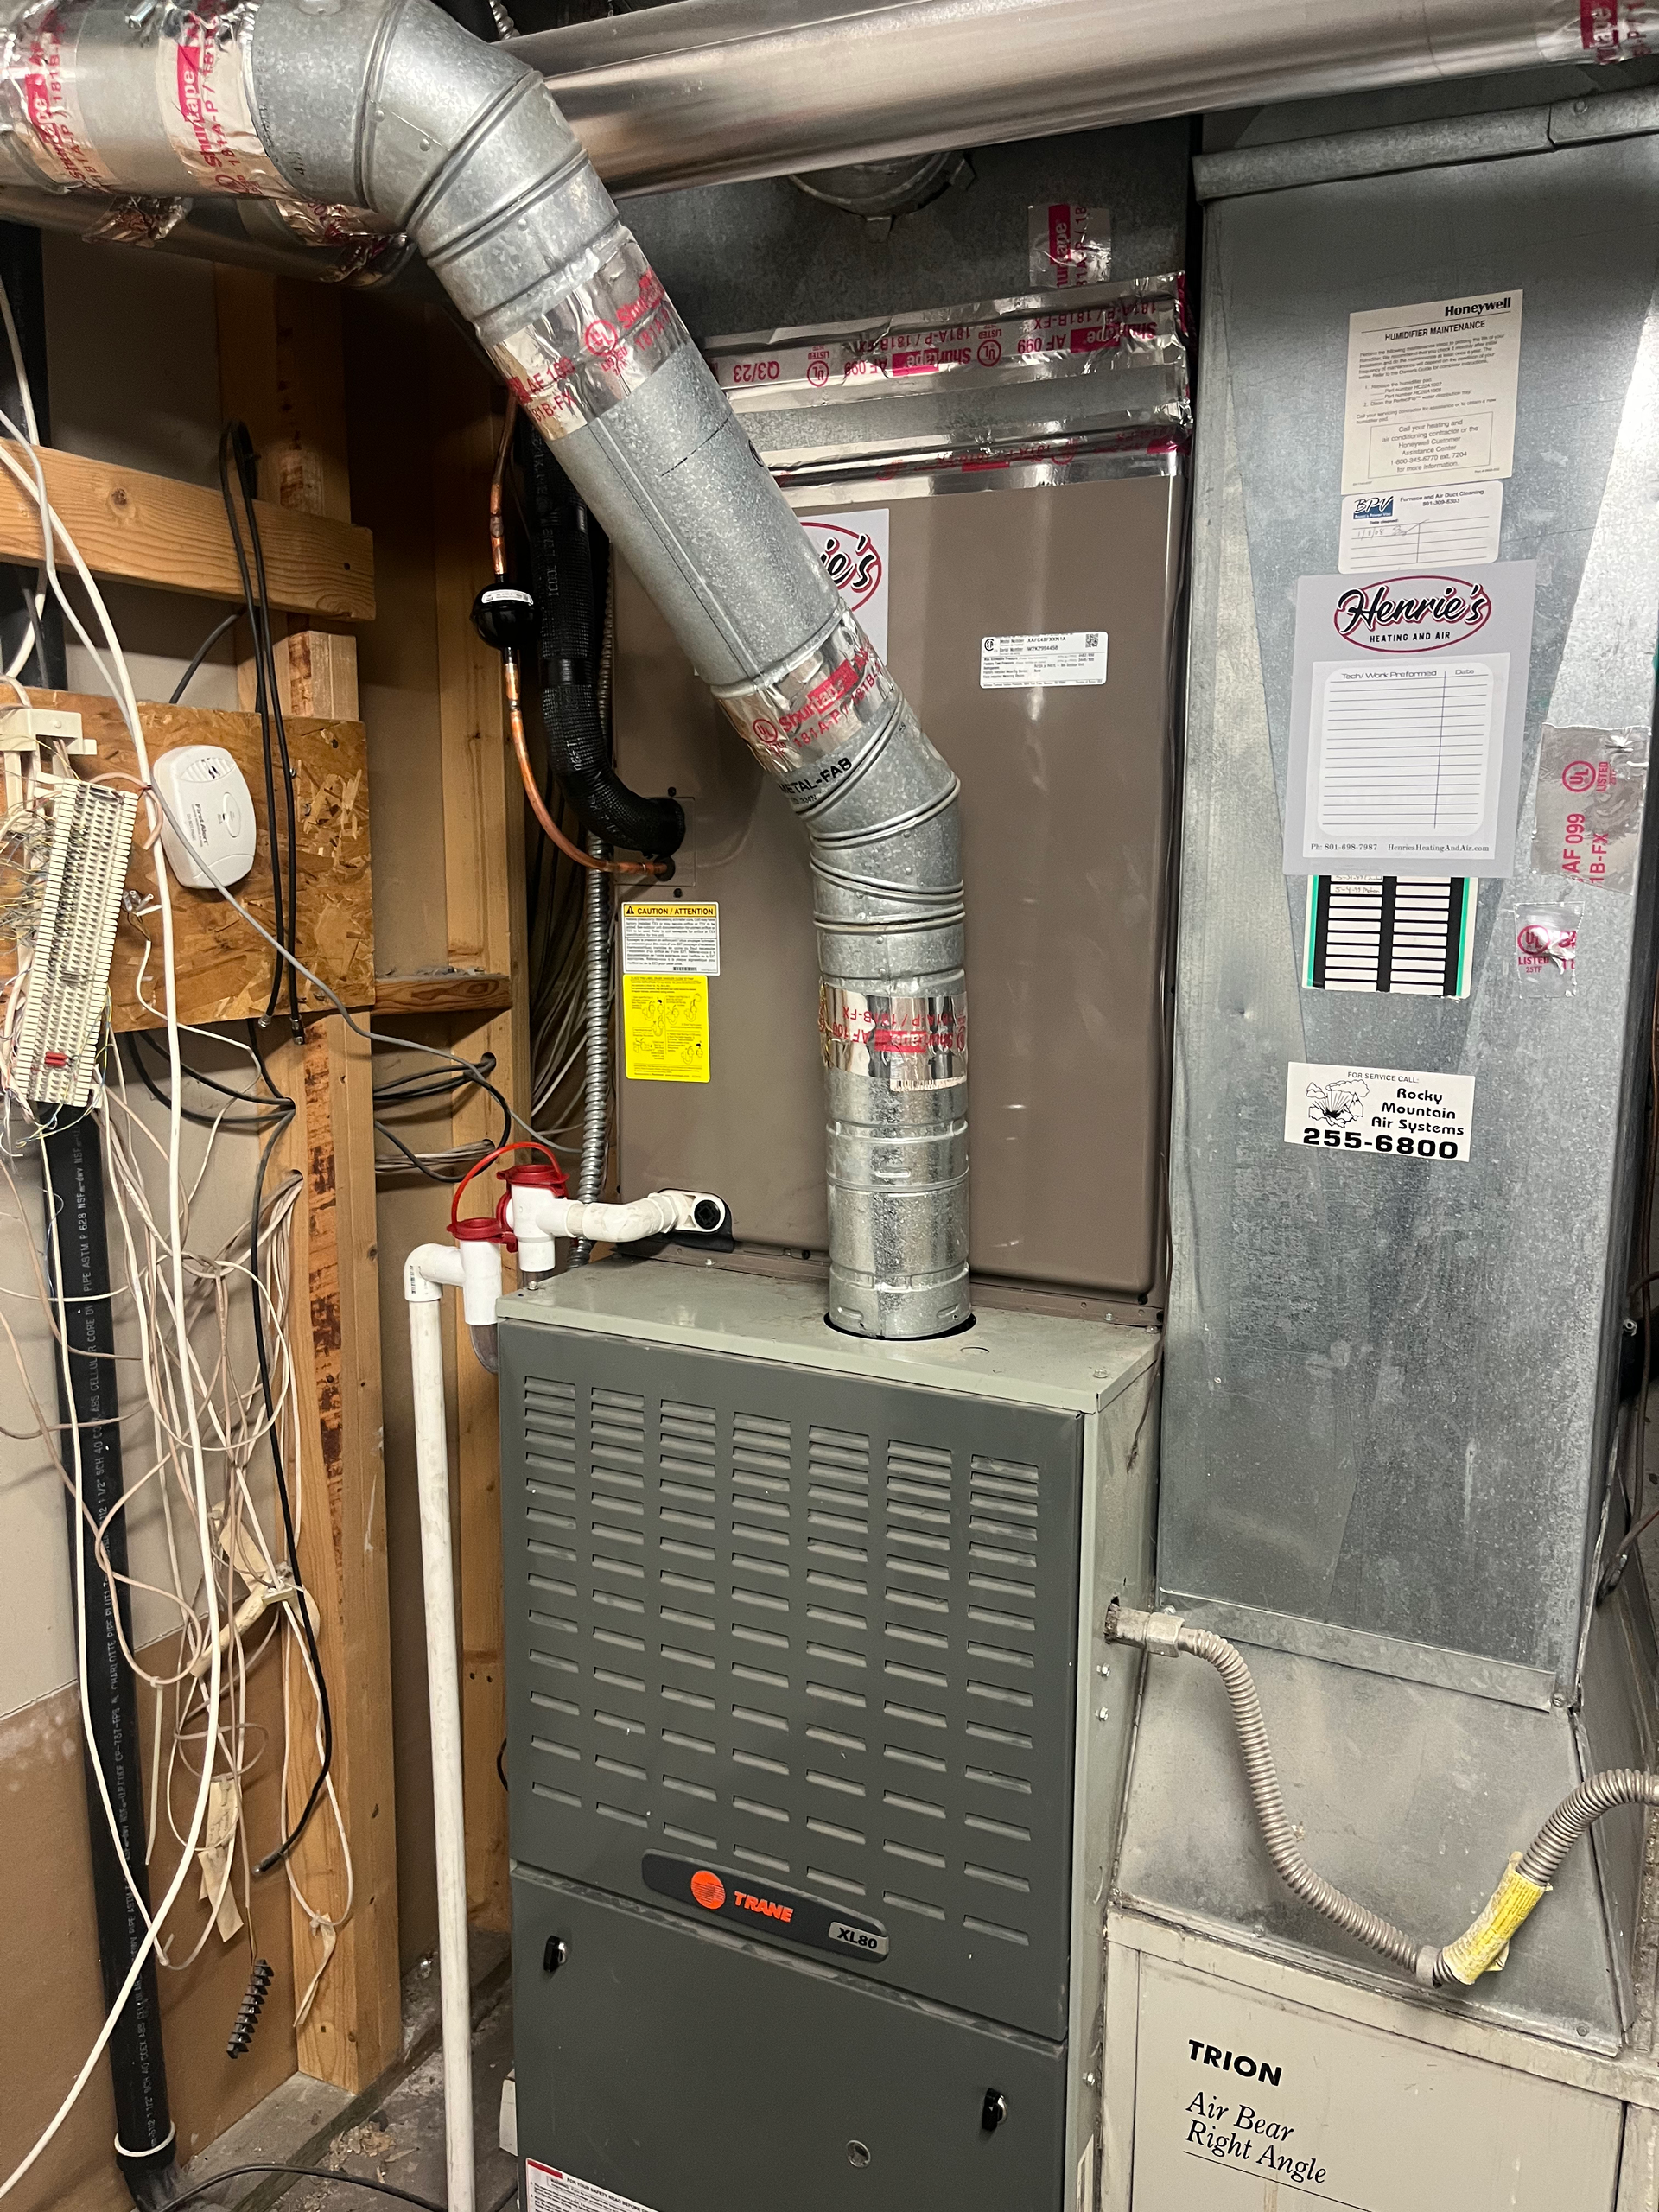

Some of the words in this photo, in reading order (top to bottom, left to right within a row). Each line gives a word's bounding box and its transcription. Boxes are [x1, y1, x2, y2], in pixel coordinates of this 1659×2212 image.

[183, 70, 223, 168] Shurtape
[205, 100, 241, 167] 181A-P
[1445, 296, 1512, 317] Honeywell
[1034, 311, 1084, 330] 181B-FX
[1384, 328, 1428, 341] HUMIDIFIER
[1429, 320, 1486, 335] MAINTENANCE
[924, 327, 973, 345] 181A-P
[977, 327, 1003, 340] LISTED
[1046, 334, 1068, 353] AF
[1016, 335, 1045, 355] 099
[906, 347, 973, 369] Shurtape
[733, 360, 780, 384] Q3/23
[844, 359, 870, 378] 099
[1391, 431, 1427, 442] conditioning
[1428, 428, 1459, 437] contractor
[1411, 424, 1426, 433] your
[1398, 439, 1430, 448] Honeywell
[1431, 435, 1461, 445] Customer
[1401, 447, 1434, 456] Assistance
[1435, 444, 1457, 453] Center
[1423, 461, 1459, 470] information.
[1354, 495, 1394, 512] BPV
[1338, 583, 1489, 634] Henrie's
[1370, 633, 1408, 643] HEATING
[1412, 632, 1431, 642] AND
[1435, 631, 1451, 639] AIR
[1389, 670, 1437, 678] Preformed
[779, 677, 846, 733] Shurtape
[792, 709, 841, 748] 181A-P
[779, 757, 853, 794] METAL-FAB
[1595, 760, 1609, 793] LISTED
[194, 804, 205, 823] First
[1564, 812, 1586, 844] 099
[1387, 843, 1490, 853] HenriesHeatingAndAir.com
[1561, 848, 1581, 874] AF
[1589, 832, 1609, 888] 1B-FX
[669, 907, 674, 916] /
[1517, 956, 1550, 966] LISTED
[851, 1028, 871, 1045] AF
[1364, 1072, 1396, 1082] SERVICE
[1397, 1075, 1420, 1084] CALL:
[1396, 1087, 1444, 1105] Rocky
[1381, 1101, 1456, 1120] Mountain
[1370, 1116, 1394, 1128] Air
[1398, 1119, 1465, 1136] Systems
[1303, 1127, 1459, 1160] 255-6800
[78, 1213, 88, 1231] 628
[80, 1243, 91, 1268] ASTM
[82, 1272, 92, 1292] PIPE
[86, 1318, 96, 1343] CORE
[88, 1345, 99, 1392] CELLULR
[90, 1395, 100, 1412] ABS
[94, 1441, 104, 1455] 40
[96, 1456, 105, 1476] SCH
[734, 1890, 794, 1923] TRANE
[836, 1927, 878, 1949] XL80
[1188, 2038, 1283, 2087] TRION
[1185, 2091, 1230, 2121] Air
[1233, 2103, 1294, 2142] Bear
[1185, 2119, 1253, 2160] Right
[1255, 2144, 1327, 2184] Angle
[566, 2177, 577, 2185] FOR
